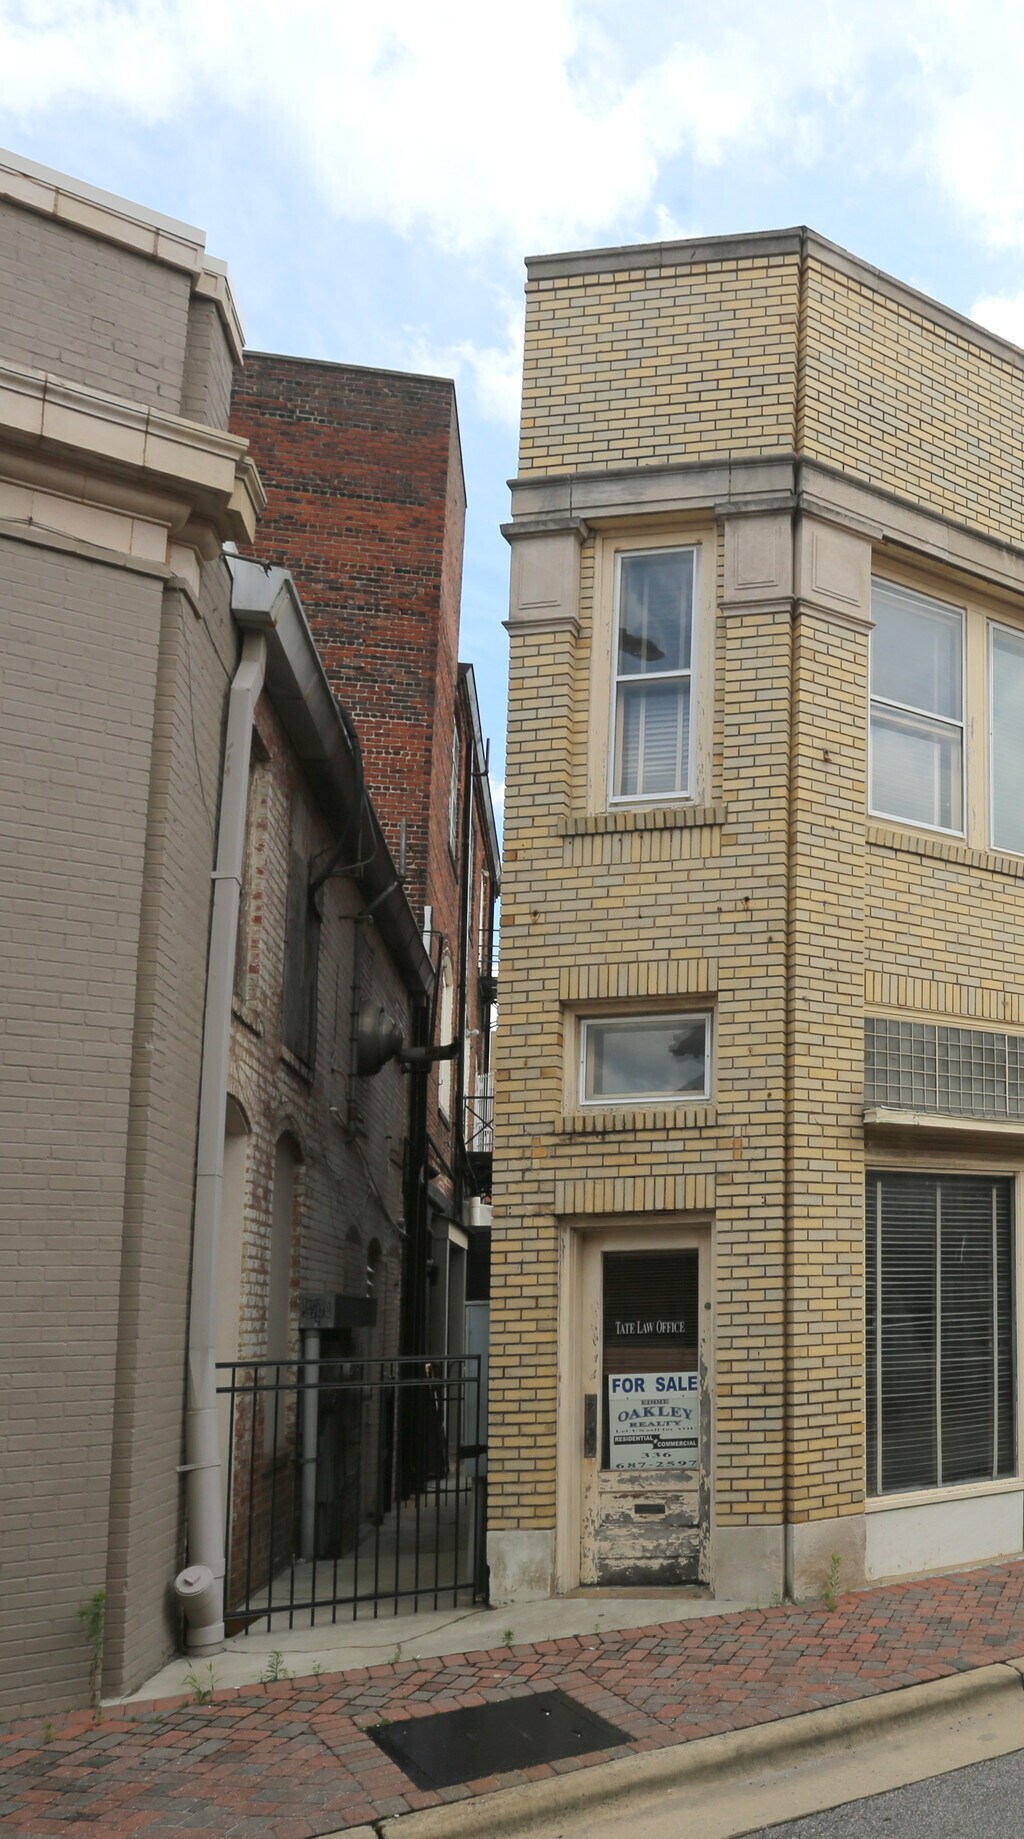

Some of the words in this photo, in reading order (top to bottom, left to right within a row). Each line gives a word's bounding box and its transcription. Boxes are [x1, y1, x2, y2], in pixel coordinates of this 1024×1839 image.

[615, 1321, 635, 1335] TATE
[637, 1320, 654, 1334] LAW
[656, 1320, 685, 1334] OFFICE
[612, 1378, 645, 1393] FOR
[656, 1376, 697, 1392] SALE
[618, 1406, 692, 1422] OAKLEY
